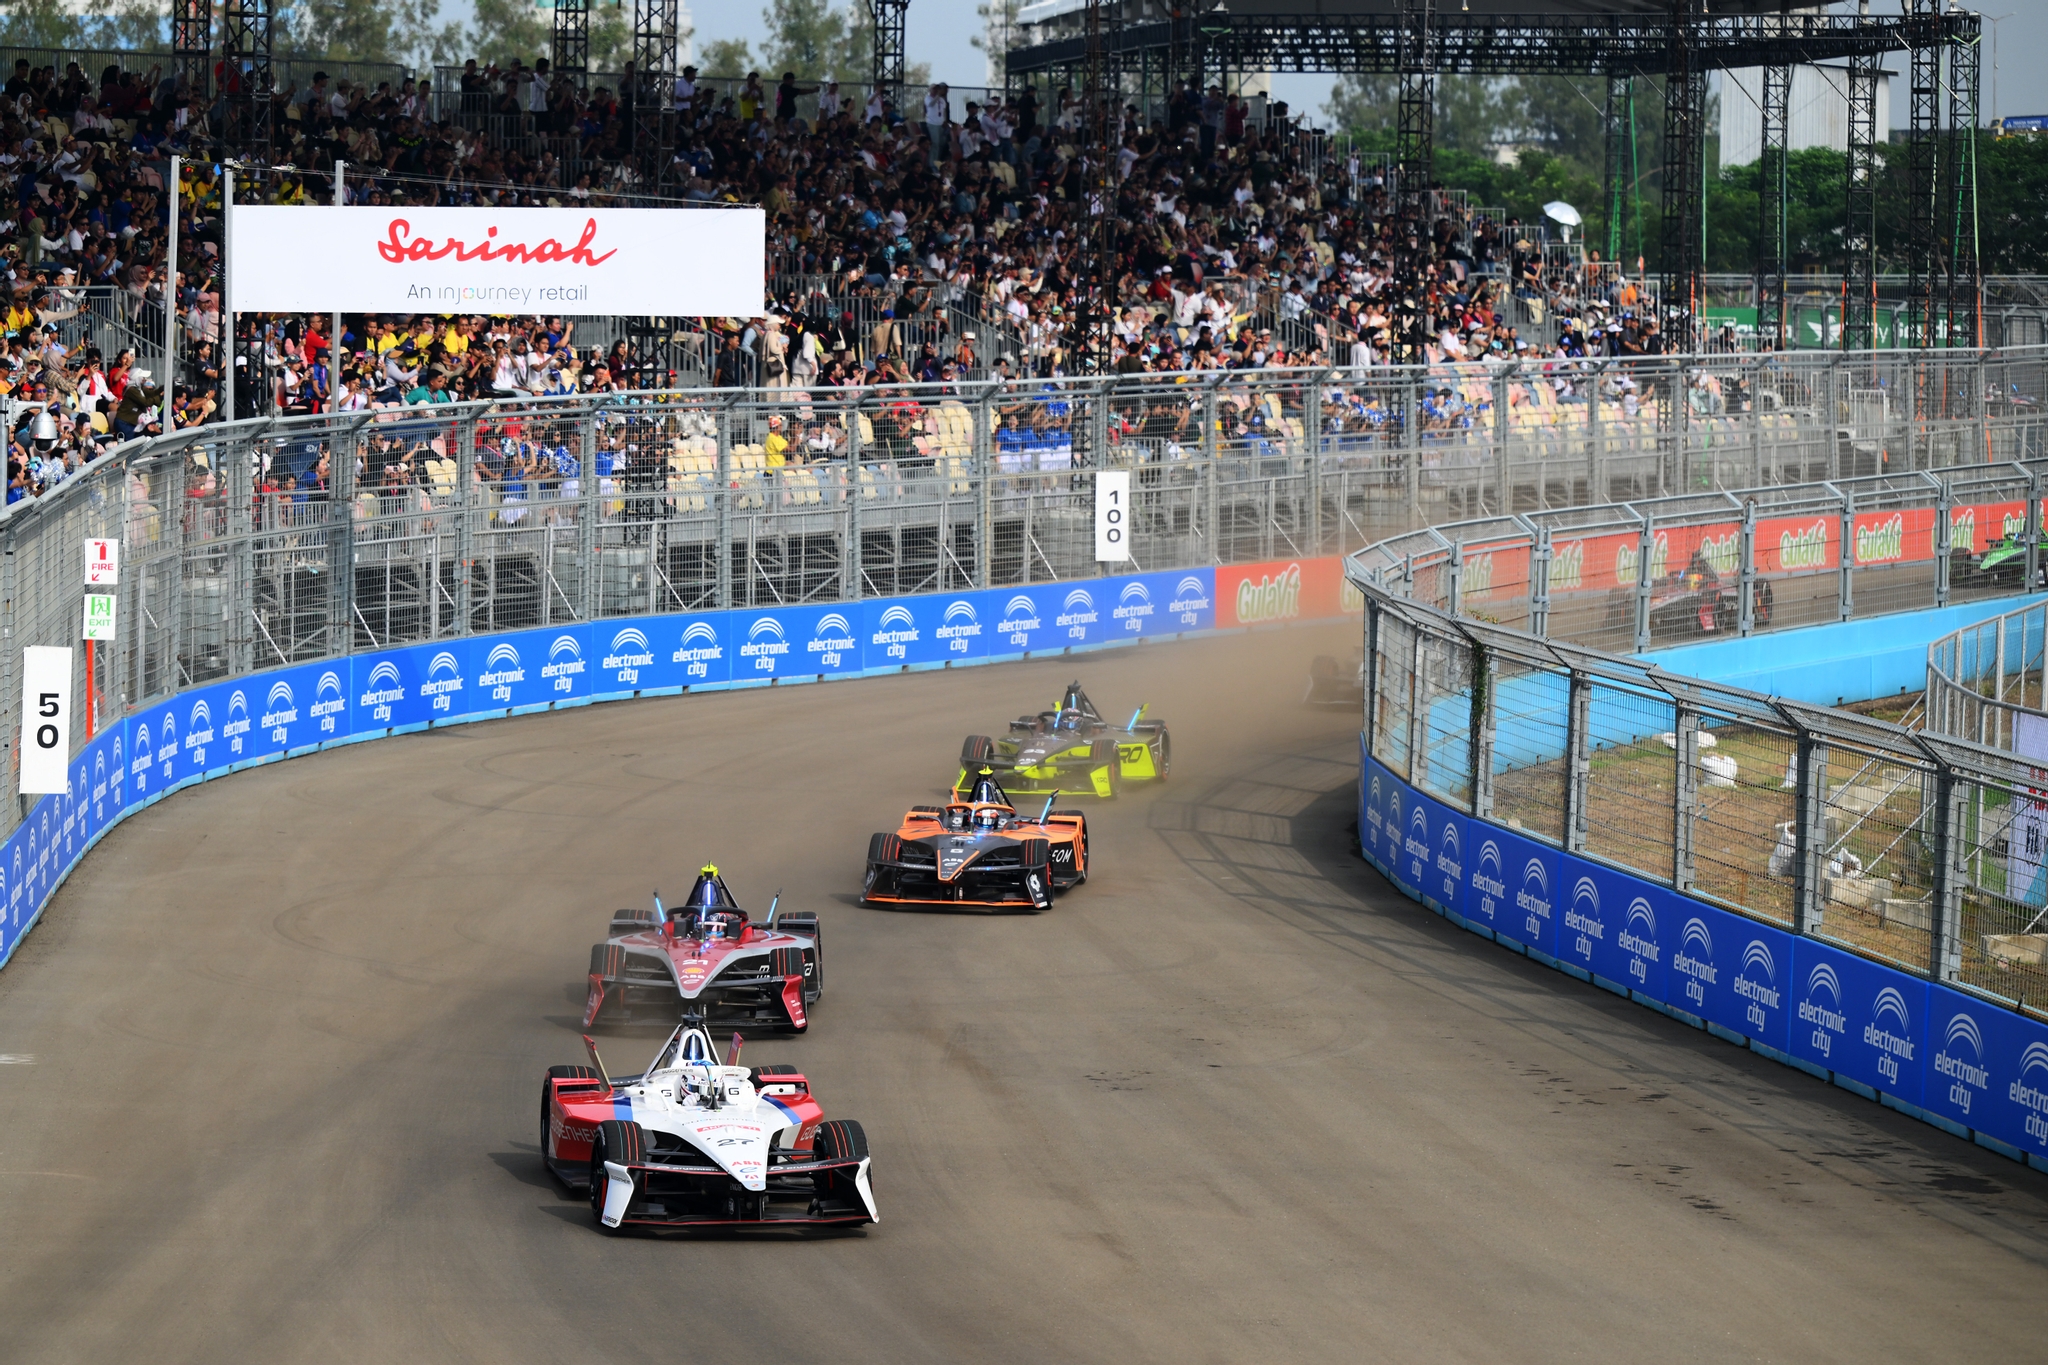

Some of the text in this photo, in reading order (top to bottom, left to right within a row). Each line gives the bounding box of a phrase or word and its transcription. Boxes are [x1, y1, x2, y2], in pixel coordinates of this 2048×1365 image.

[378, 218, 617, 266] Sarinah
[407, 284, 587, 304] An injourney retail
[1113, 602, 1154, 618] electronic
[1169, 597, 1209, 613] electronic
[998, 617, 1041, 633] electronic
[1056, 610, 1098, 626] electronic
[1126, 617, 1142, 632] city
[1181, 611, 1197, 625] city
[873, 628, 919, 644] electronic
[936, 622, 982, 639] electronic
[1011, 631, 1028, 646] city
[1069, 625, 1086, 640] city
[673, 644, 722, 663] electronic
[740, 639, 789, 657] electronic
[808, 636, 855, 652] electronic
[888, 643, 906, 658] city
[950, 637, 968, 652] city
[541, 658, 586, 678] electronic
[603, 651, 654, 668] electronic
[688, 661, 707, 677] city
[755, 654, 774, 671] city
[822, 651, 840, 667] city
[421, 675, 463, 696] electronic
[479, 667, 525, 686] electronic
[554, 675, 572, 692] city
[618, 667, 638, 684] city
[361, 685, 404, 706] electronic
[434, 694, 450, 711] city
[493, 684, 511, 701] city
[310, 696, 345, 717] electronic
[374, 704, 391, 721] city
[36, 693, 60, 749] 50
[224, 716, 250, 737] electronic
[262, 706, 298, 728] electronic
[321, 715, 334, 732] city
[186, 727, 214, 749] electronic
[232, 736, 242, 754] city
[273, 726, 287, 744] city
[194, 745, 205, 764] city
[1406, 835, 1429, 862] electronic
[1412, 858, 1422, 882] city
[1438, 852, 1461, 880] electronic
[1444, 876, 1454, 900] city
[1473, 870, 1505, 898] electronic
[1482, 894, 1494, 920] city
[1517, 888, 1551, 918] electronic
[1526, 913, 1540, 940] city
[1565, 908, 1604, 939] electronic
[1576, 934, 1592, 961] city
[1619, 929, 1660, 962] electronic
[1630, 958, 1646, 984] city
[1674, 950, 1717, 984] electronic
[1686, 978, 1703, 1006] city
[1734, 974, 1780, 1009] electronic
[1747, 1002, 1765, 1032] city
[1799, 998, 1846, 1034] electronic
[1812, 1027, 1830, 1058] city
[1864, 1022, 1914, 1060] electronic
[1878, 1053, 1898, 1084] city
[1935, 1050, 1988, 1089] electronic
[1950, 1081, 1971, 1114] city
[2009, 1078, 2048, 1114] electro
[2026, 1116, 2048, 1146] city
[718, 1138, 754, 1146] 27
